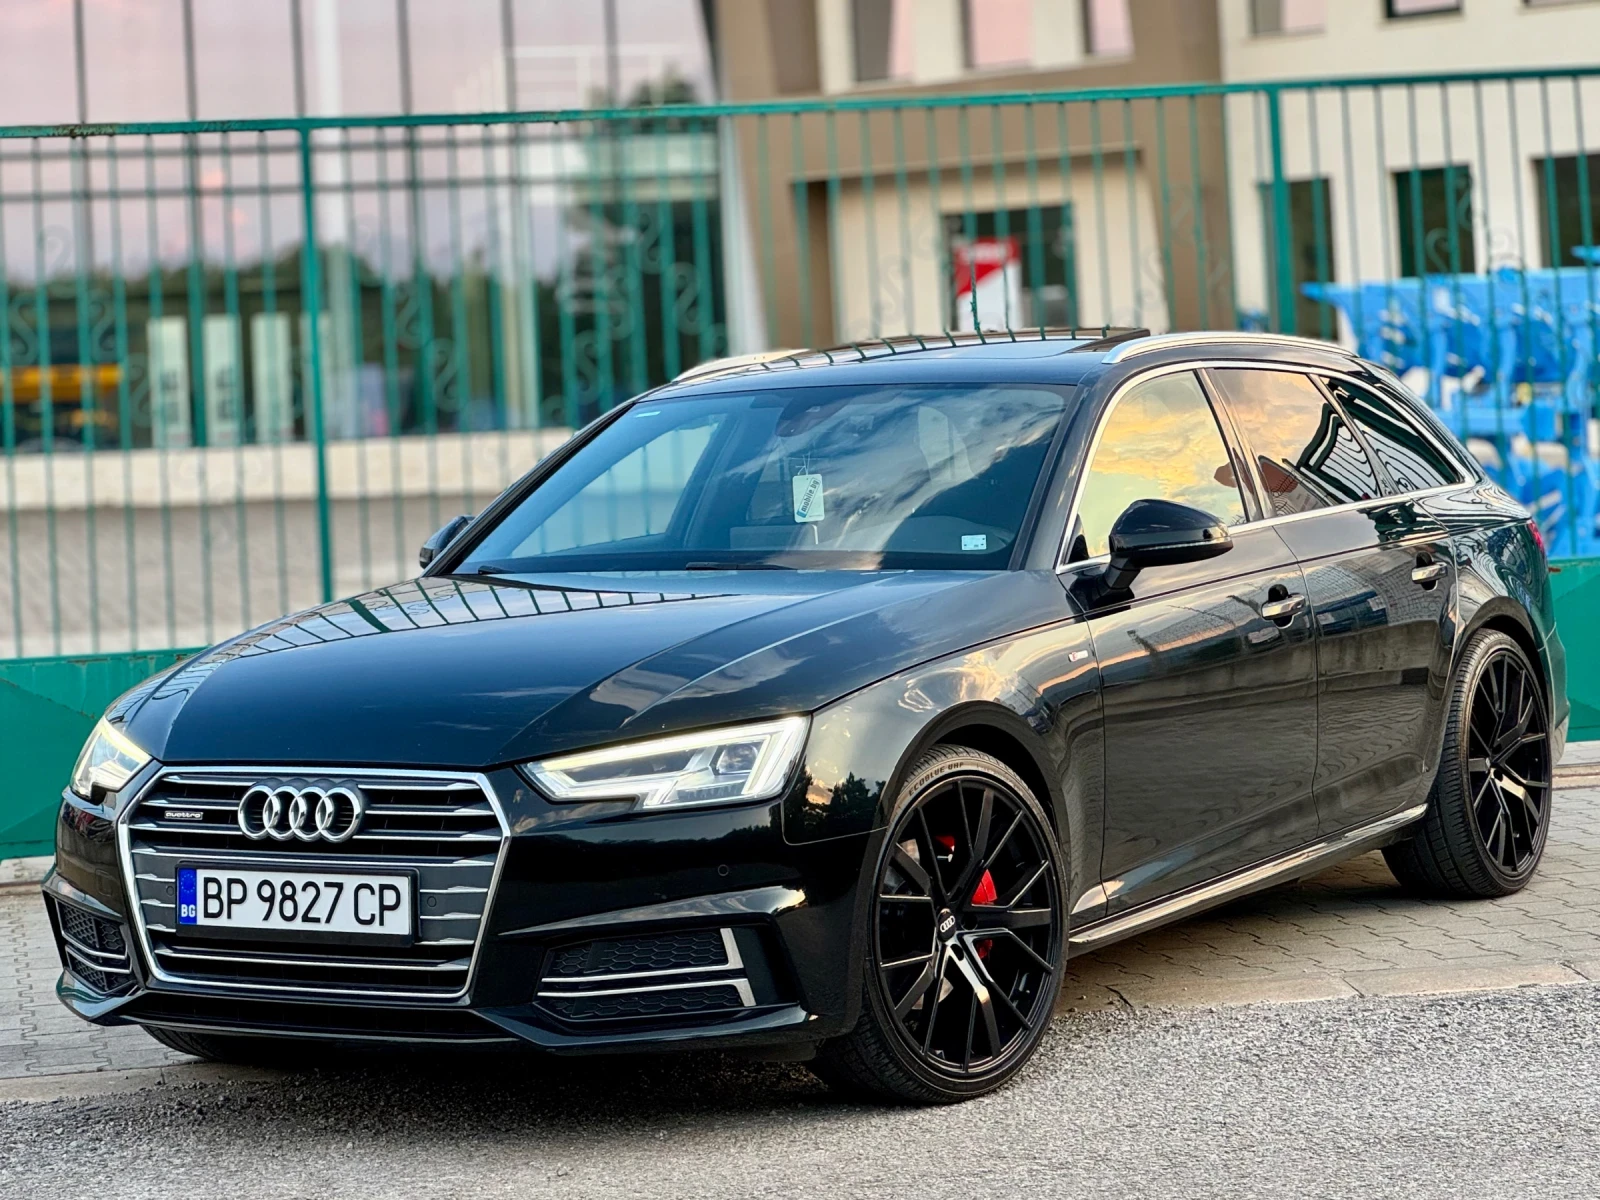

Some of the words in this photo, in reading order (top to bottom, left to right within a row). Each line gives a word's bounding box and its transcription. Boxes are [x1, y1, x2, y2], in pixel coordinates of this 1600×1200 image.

[908, 766, 946, 797] ECOBLUE
[947, 762, 964, 771] UHP
[180, 903, 197, 918] BG
[203, 876, 248, 920] BP
[256, 879, 344, 924] 9827
[354, 882, 401, 927] CP
